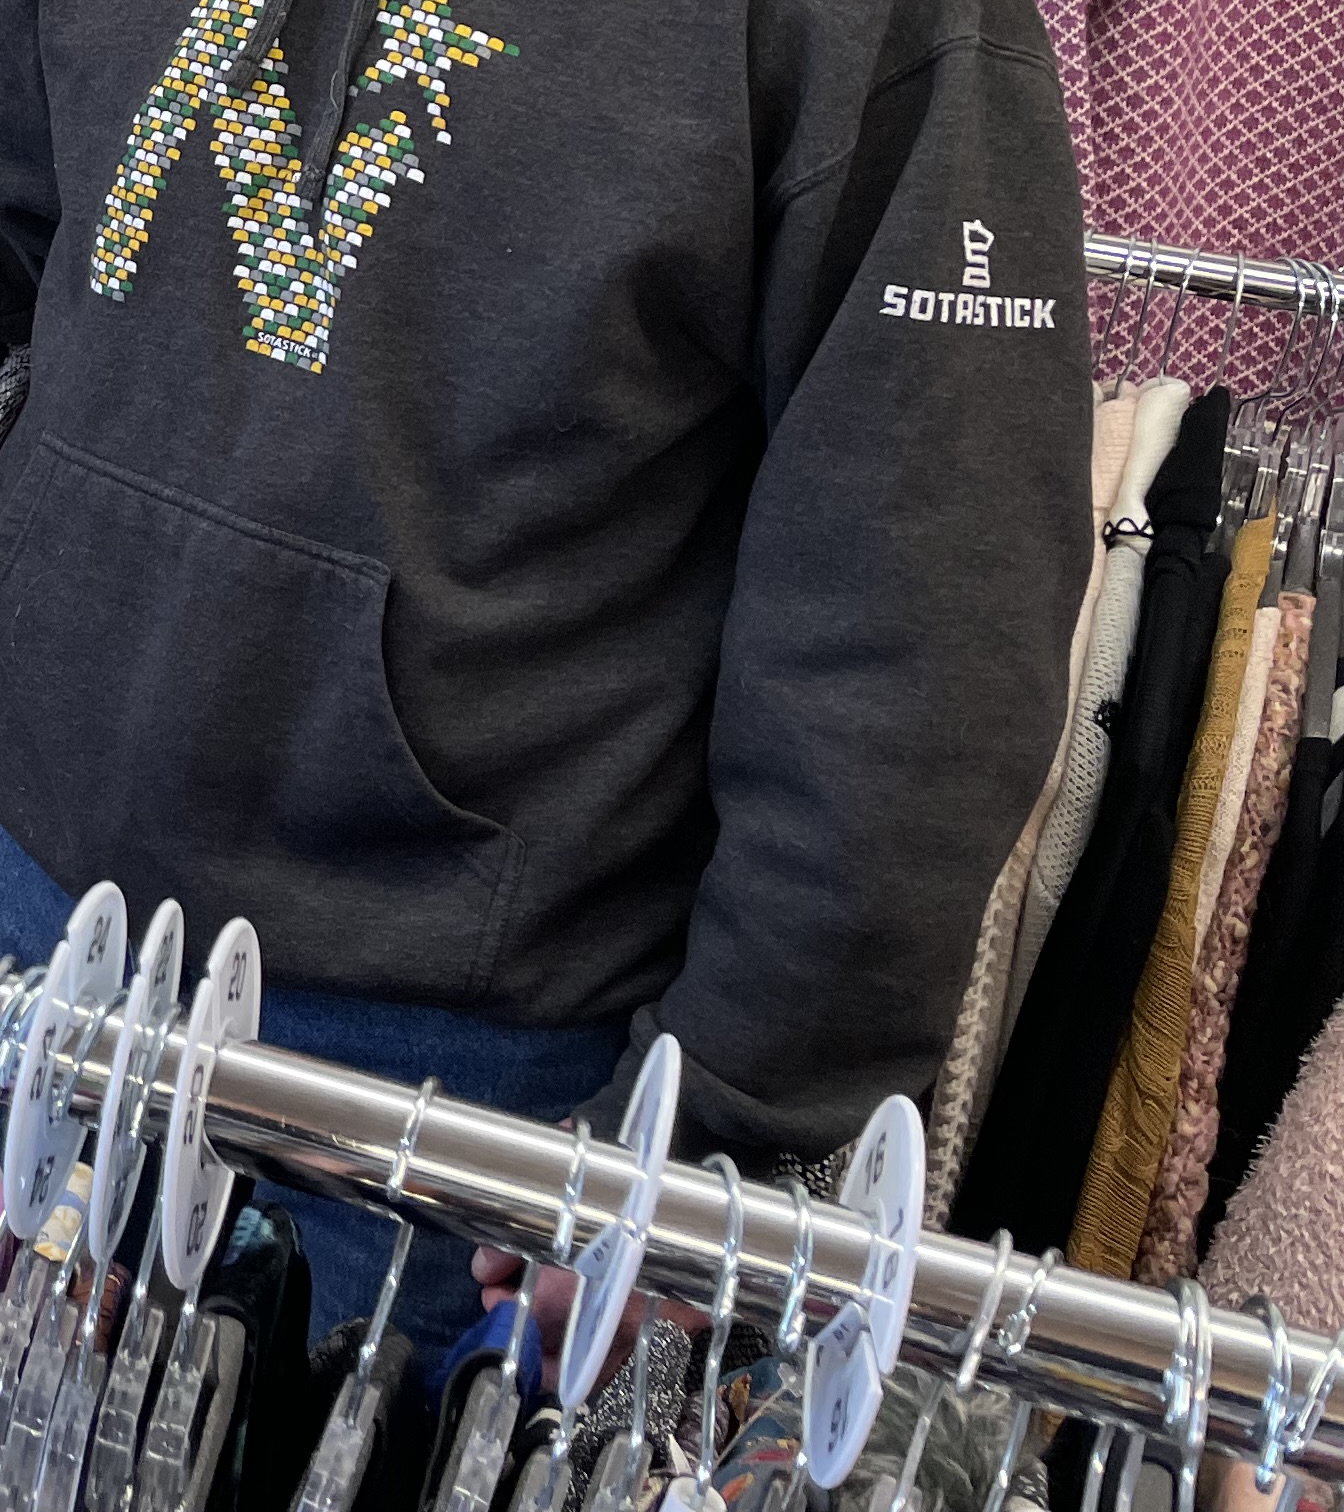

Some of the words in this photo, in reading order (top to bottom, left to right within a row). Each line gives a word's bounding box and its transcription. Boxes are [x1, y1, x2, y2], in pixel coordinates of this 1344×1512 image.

[879, 284, 1057, 330] SOTASTICK
[257, 331, 312, 359] SOTASTICK
[86, 915, 113, 964] 24
[227, 951, 247, 1002] 20
[863, 1131, 888, 1196] 16
